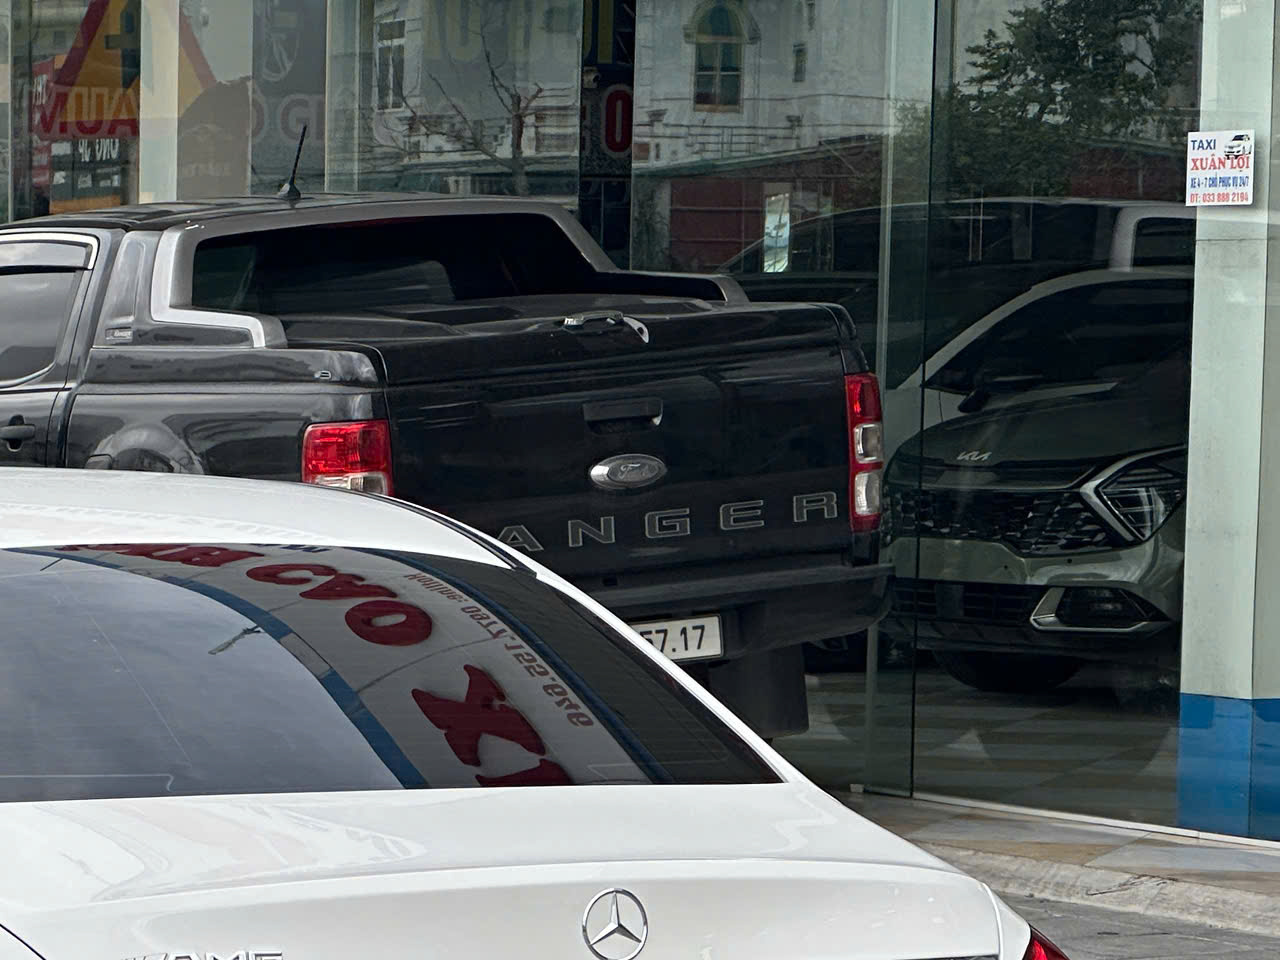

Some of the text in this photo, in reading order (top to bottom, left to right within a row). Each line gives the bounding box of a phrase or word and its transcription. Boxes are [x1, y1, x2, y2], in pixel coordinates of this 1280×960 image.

[1190, 139, 1216, 151] TAXI
[1190, 153, 1226, 171] XUÂN
[496, 490, 838, 552] ANGER
